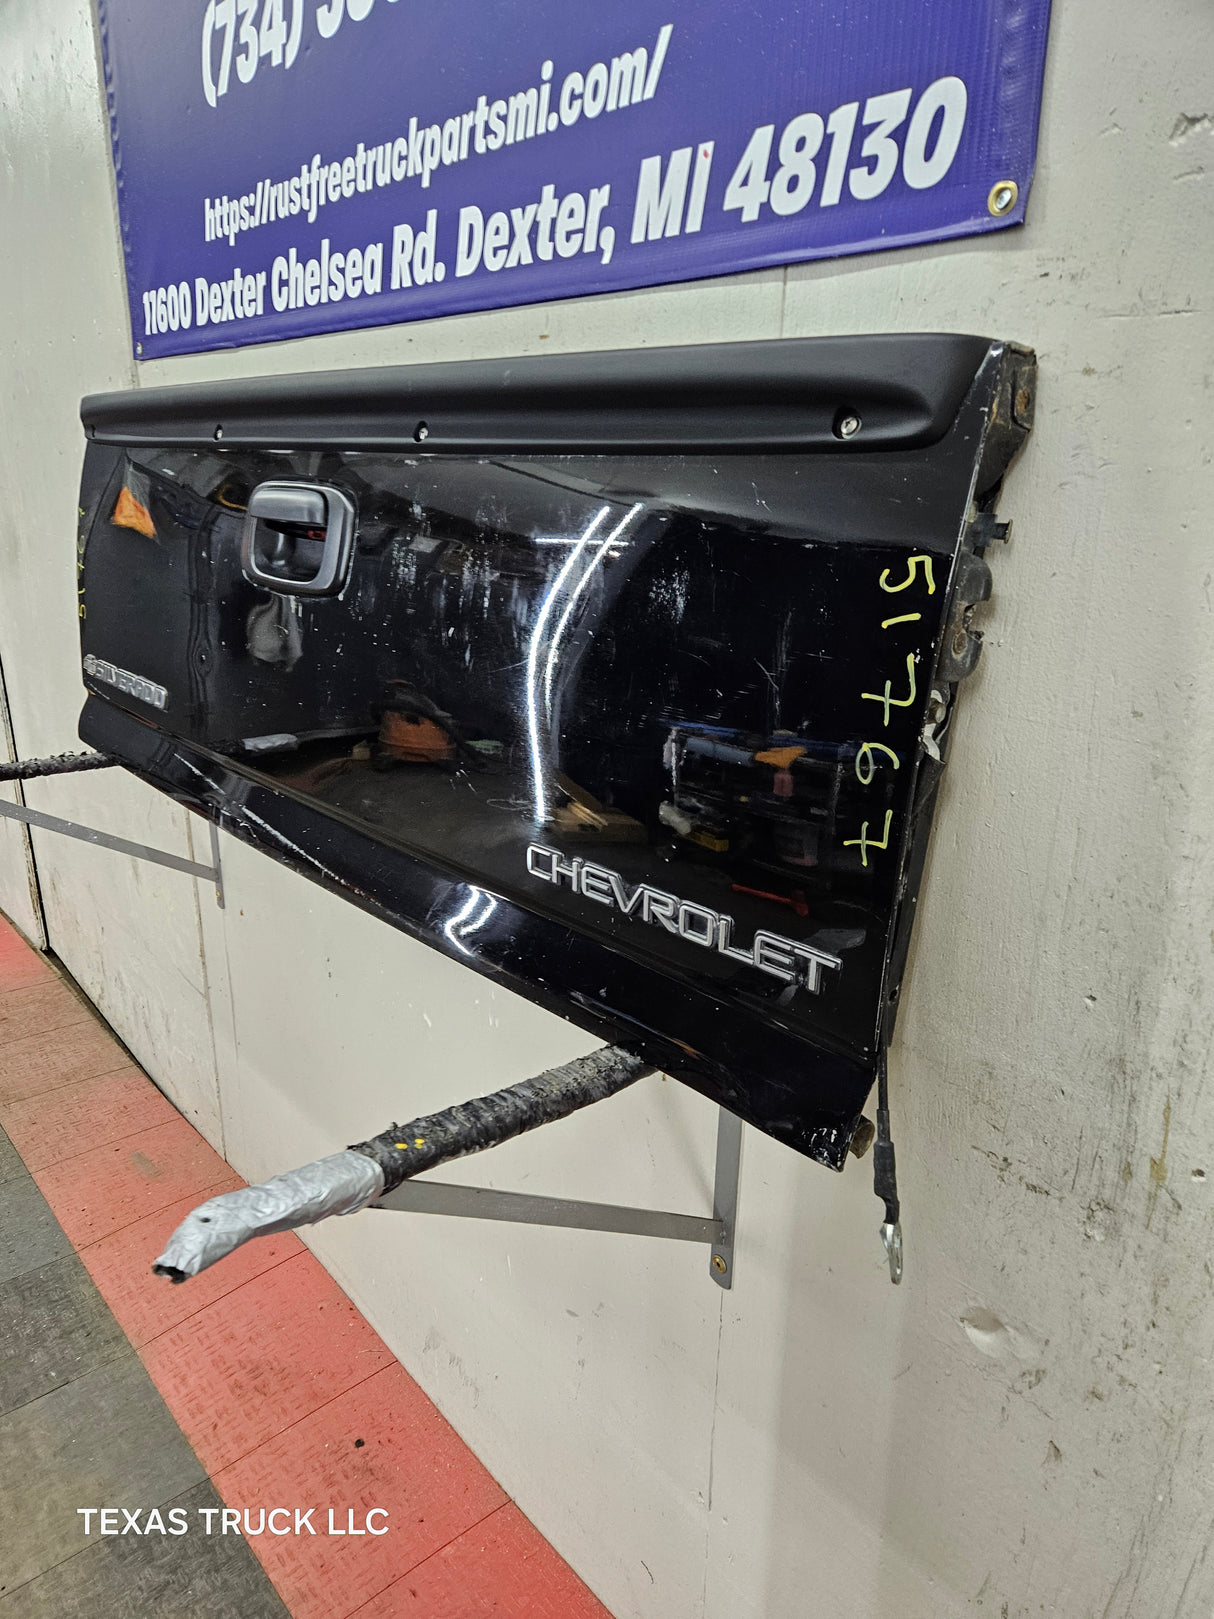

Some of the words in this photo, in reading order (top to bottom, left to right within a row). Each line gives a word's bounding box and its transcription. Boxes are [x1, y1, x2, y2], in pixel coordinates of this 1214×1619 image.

[201, 0, 304, 107] (734)
[204, 23, 674, 247] https://rustfreetruckpartsmi.com/
[142, 281, 192, 336] 11600
[195, 267, 267, 326] Dexter
[271, 239, 384, 312] Chelsea
[391, 208, 446, 290] Rd.
[455, 183, 616, 278] Dexter,
[630, 140, 715, 244] MI
[722, 75, 968, 223] 48130
[527, 842, 844, 995] CHEVROLET
